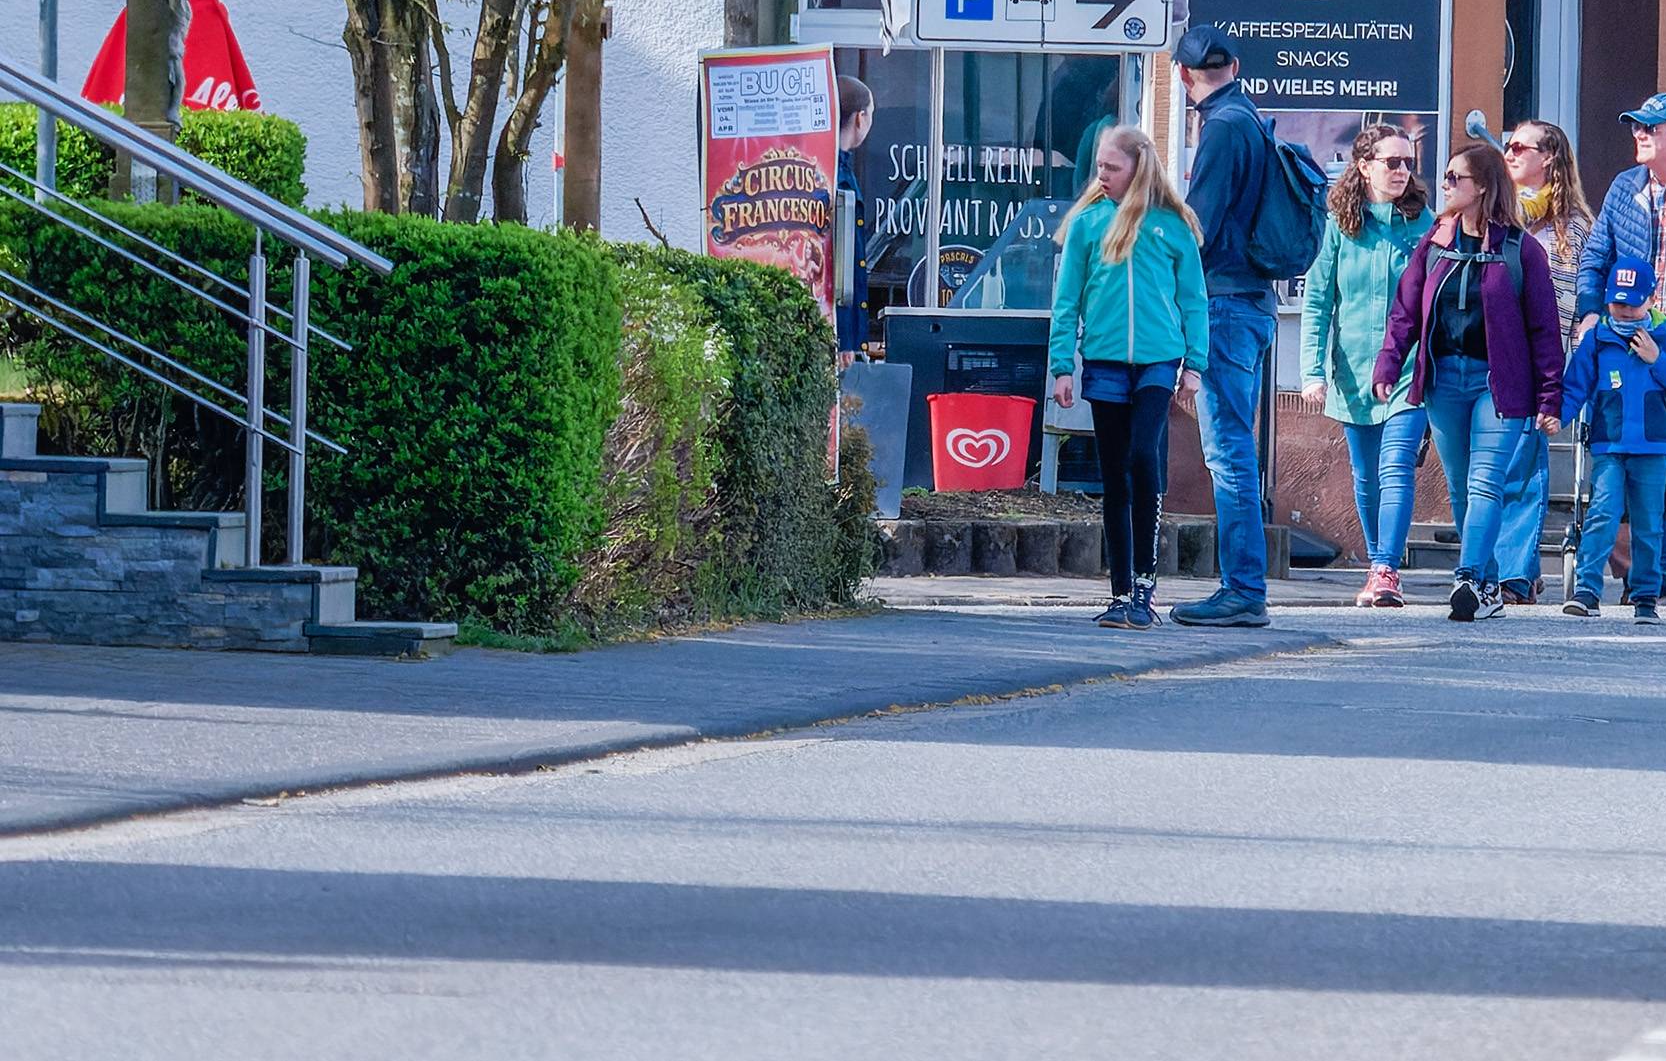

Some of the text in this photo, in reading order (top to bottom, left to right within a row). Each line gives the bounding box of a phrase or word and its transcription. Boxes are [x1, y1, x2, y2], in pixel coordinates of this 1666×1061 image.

[1276, 50, 1350, 67] SNACKS
[740, 67, 816, 96] BUCH
[1236, 78, 1398, 96] ND VIELES MEHR!
[744, 164, 814, 197] CIRCUS
[888, 144, 1041, 186] SCHELL REIN.
[722, 198, 825, 233] FRANCESCO
[875, 197, 983, 237] PROVANT
